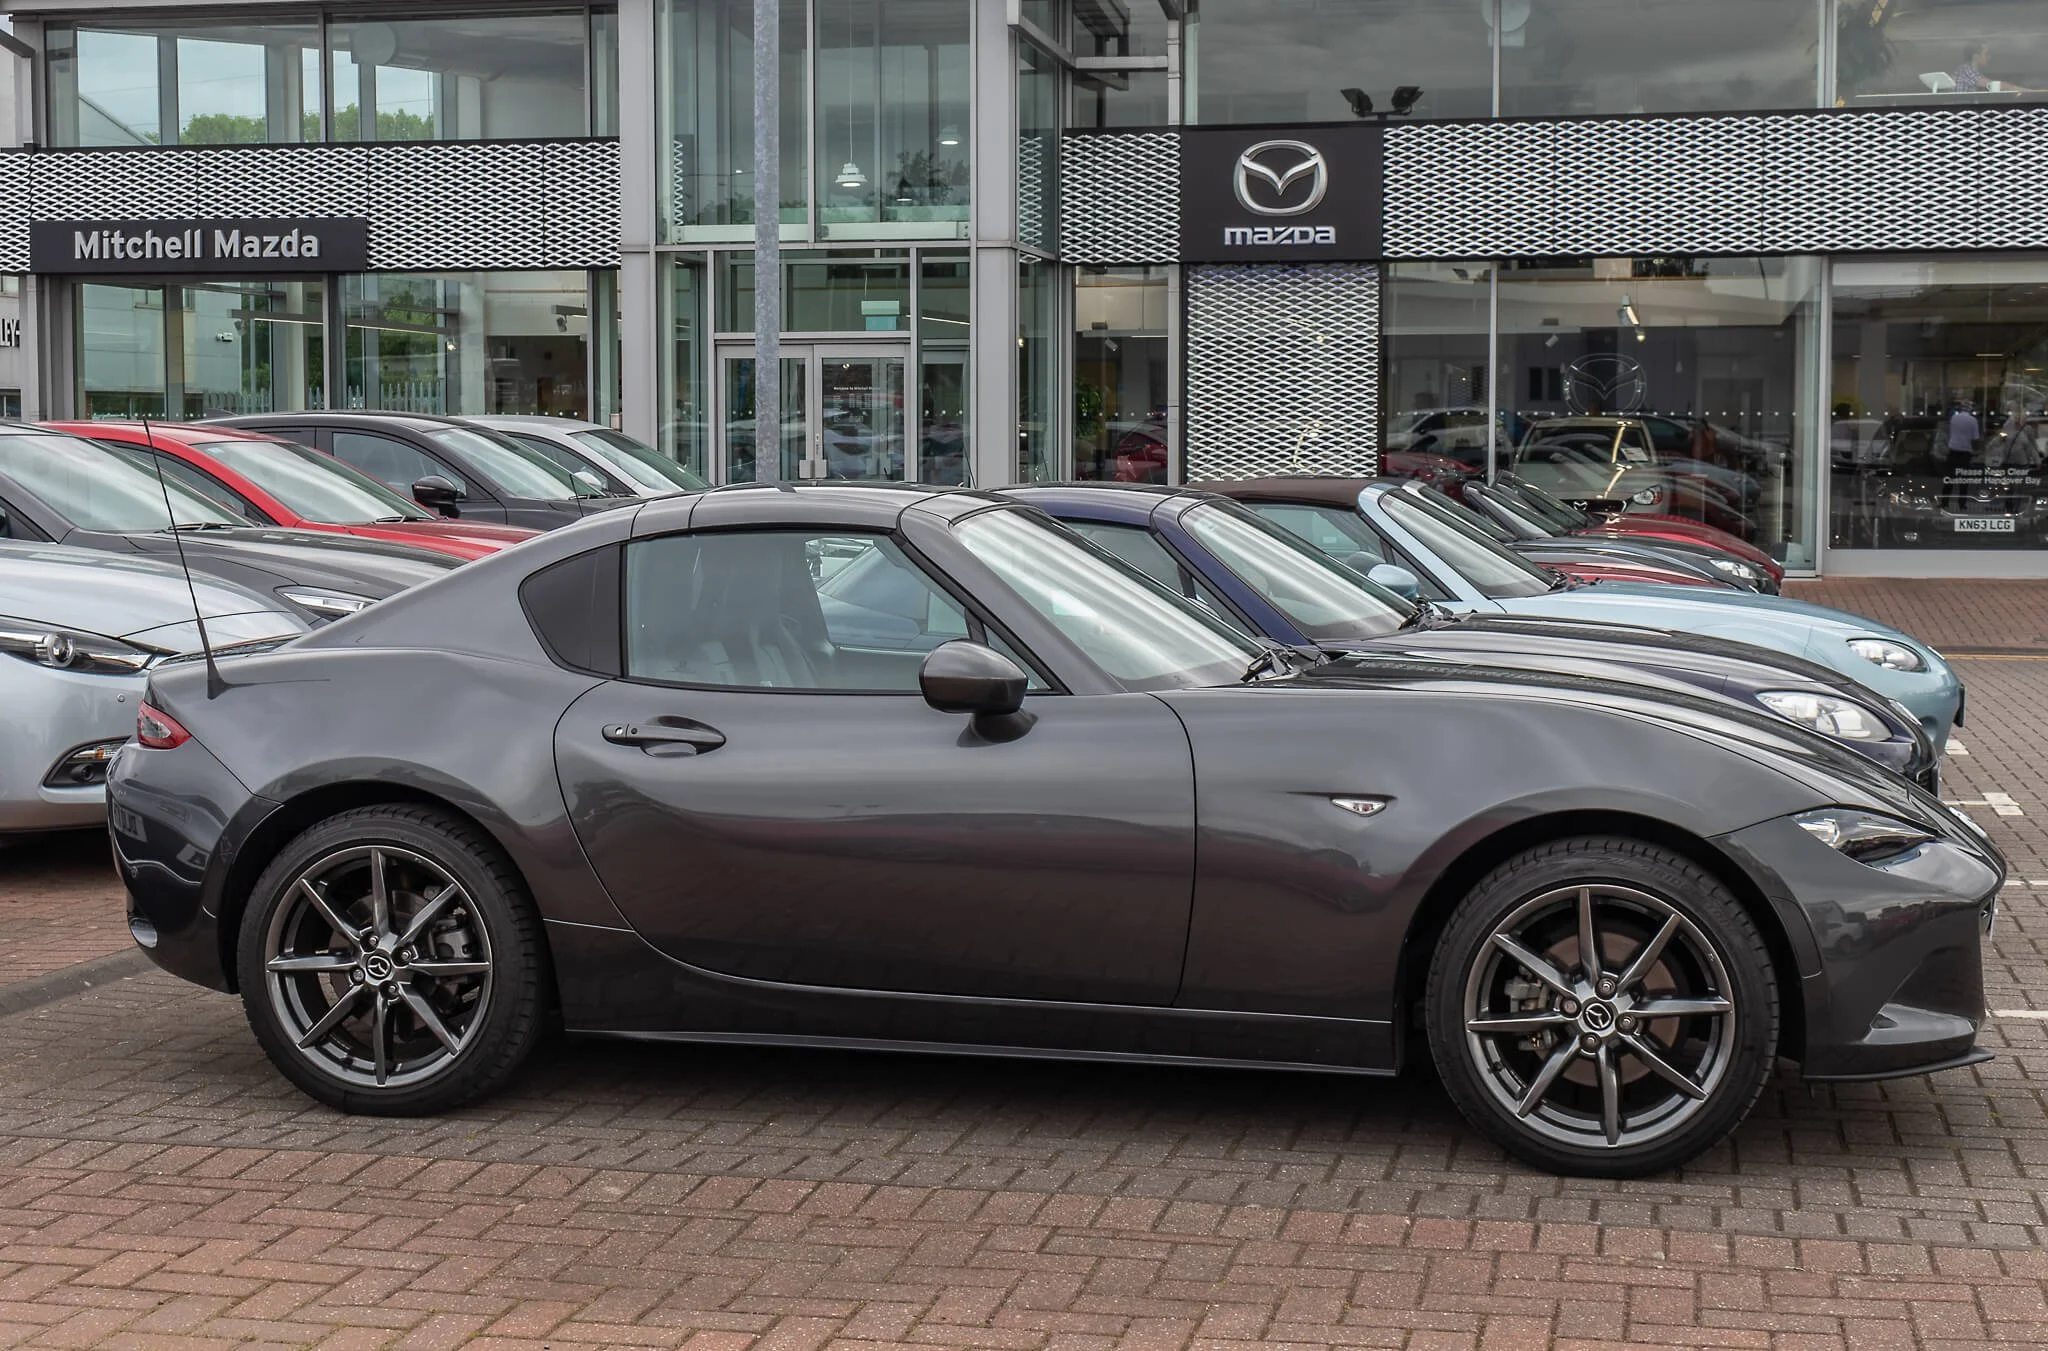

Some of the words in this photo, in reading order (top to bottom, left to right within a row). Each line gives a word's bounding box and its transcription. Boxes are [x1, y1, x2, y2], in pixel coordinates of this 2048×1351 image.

[74, 229, 201, 259] Mitchell
[214, 228, 320, 258] Mazda
[1955, 468, 1983, 476] Please
[1984, 468, 2006, 477] Keep
[2007, 468, 2030, 476] Clear
[1943, 477, 1982, 485] Customer
[1984, 477, 2024, 485] Handover
[2025, 477, 2041, 486] Bay
[1959, 520, 1987, 530] KN63
[1989, 520, 2011, 530] LCG
